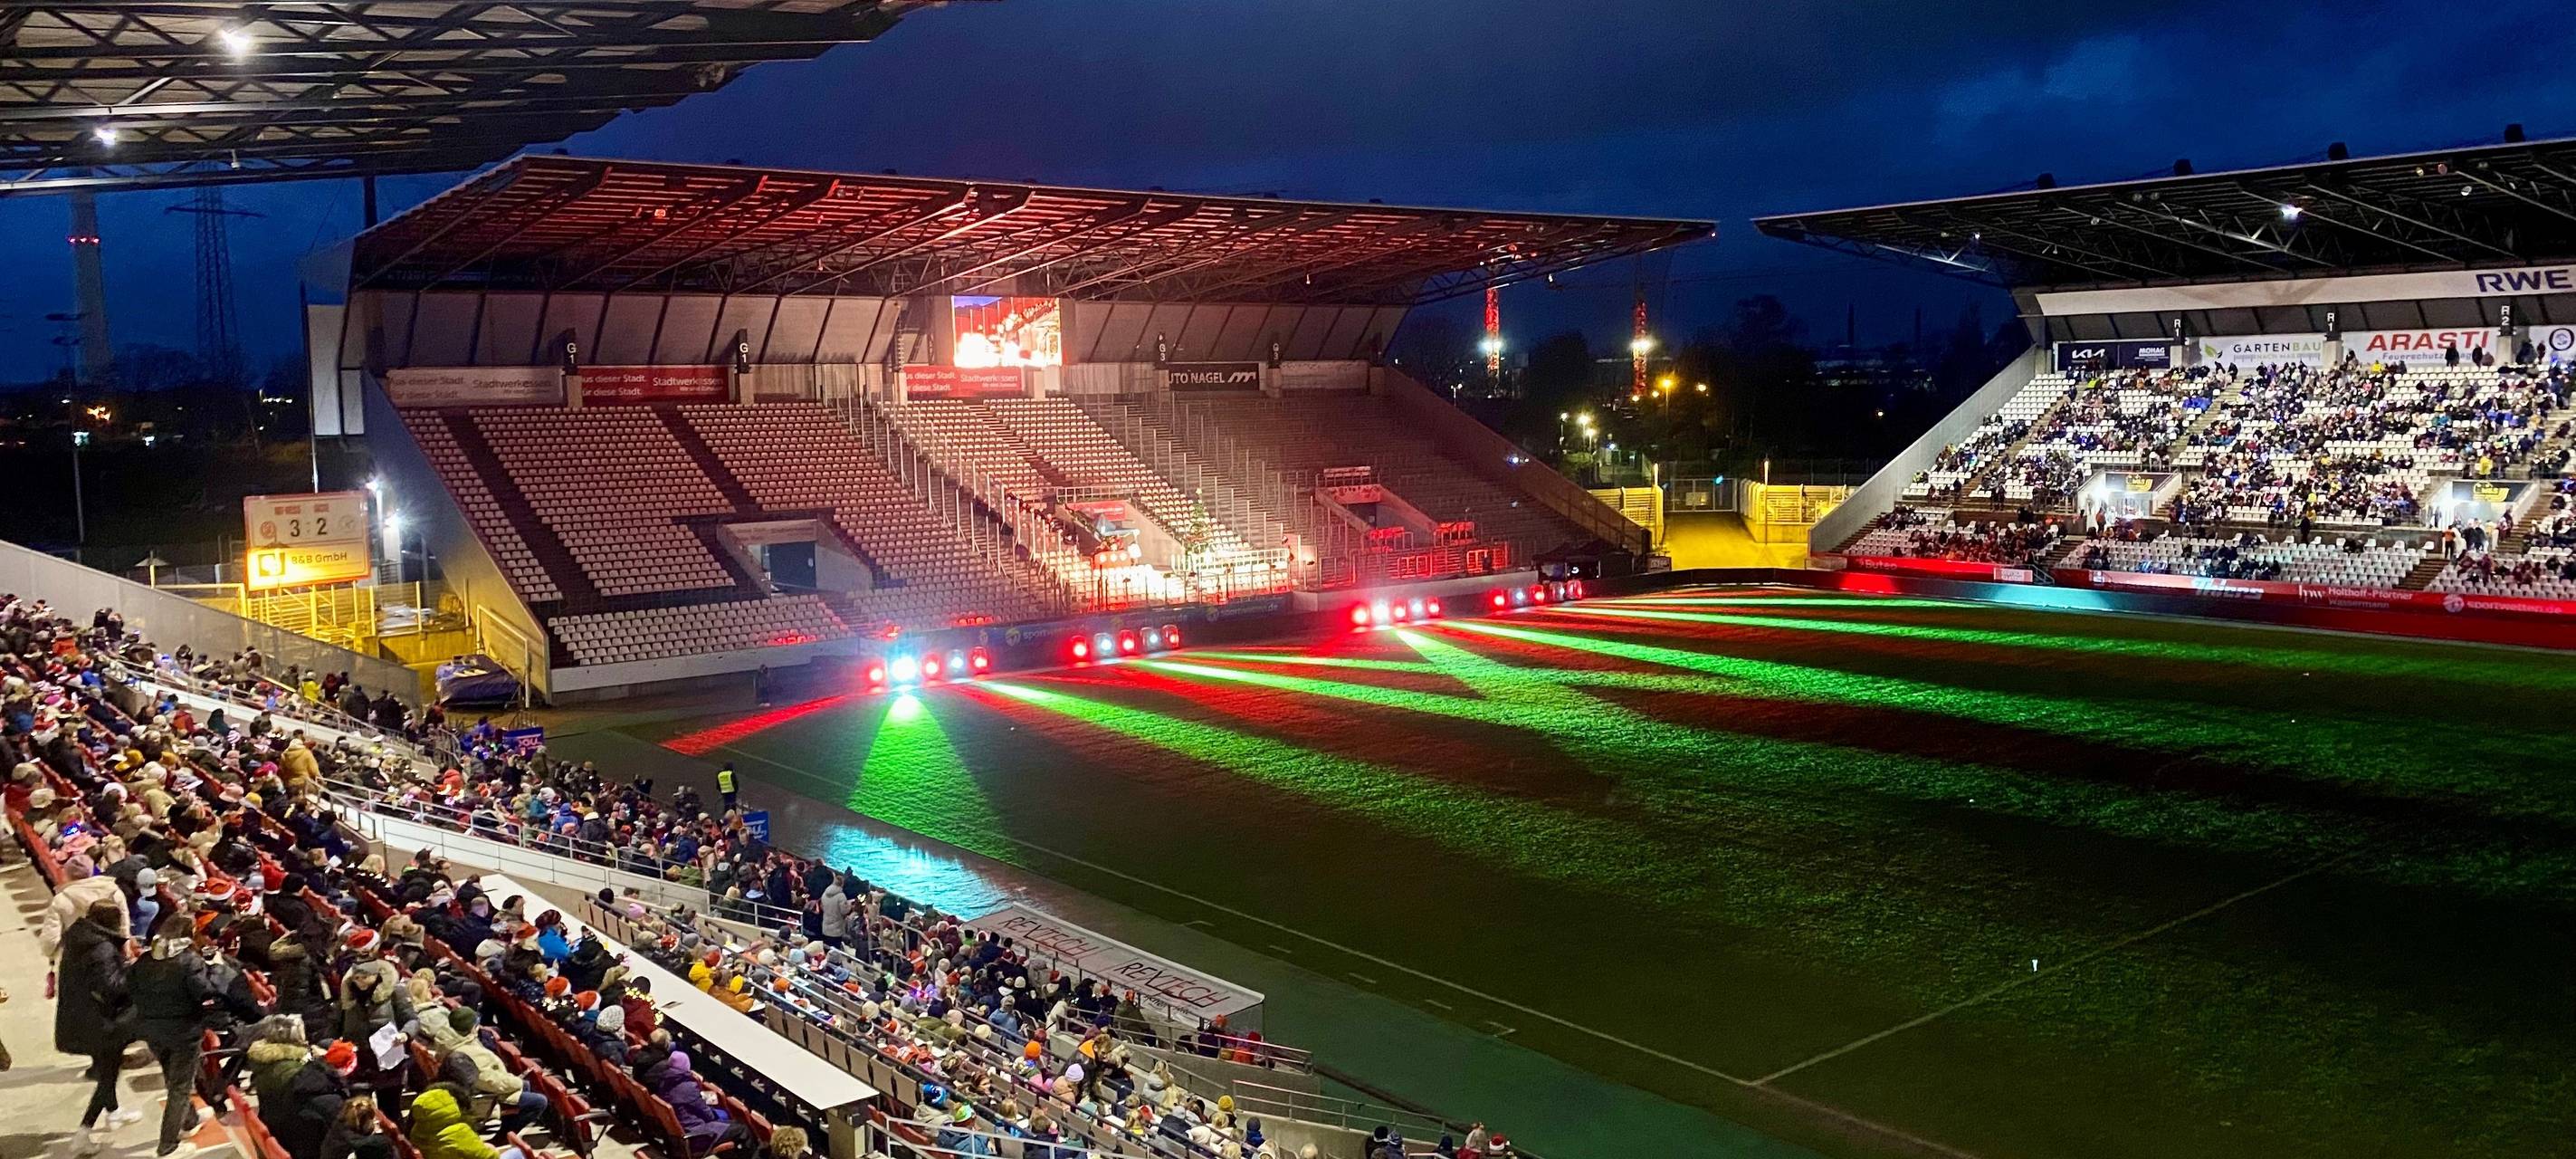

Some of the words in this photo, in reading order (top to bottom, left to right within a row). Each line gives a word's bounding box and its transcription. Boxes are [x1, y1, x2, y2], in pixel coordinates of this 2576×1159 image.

[2476, 269, 2572, 292] RWE
[2366, 330, 2490, 351] ARASTI
[2234, 342, 2321, 353] GARTENBAU
[595, 375, 621, 383] dieser
[960, 374, 1017, 384] Stadtwerkssen
[1169, 372, 1188, 384] UTO
[1190, 372, 1225, 384] NAGEL
[594, 388, 617, 397] diese
[290, 519, 301, 537] 3
[317, 517, 327, 535] 2
[315, 551, 348, 563] GmbH
[1113, 963, 1230, 1008] REXTECH
